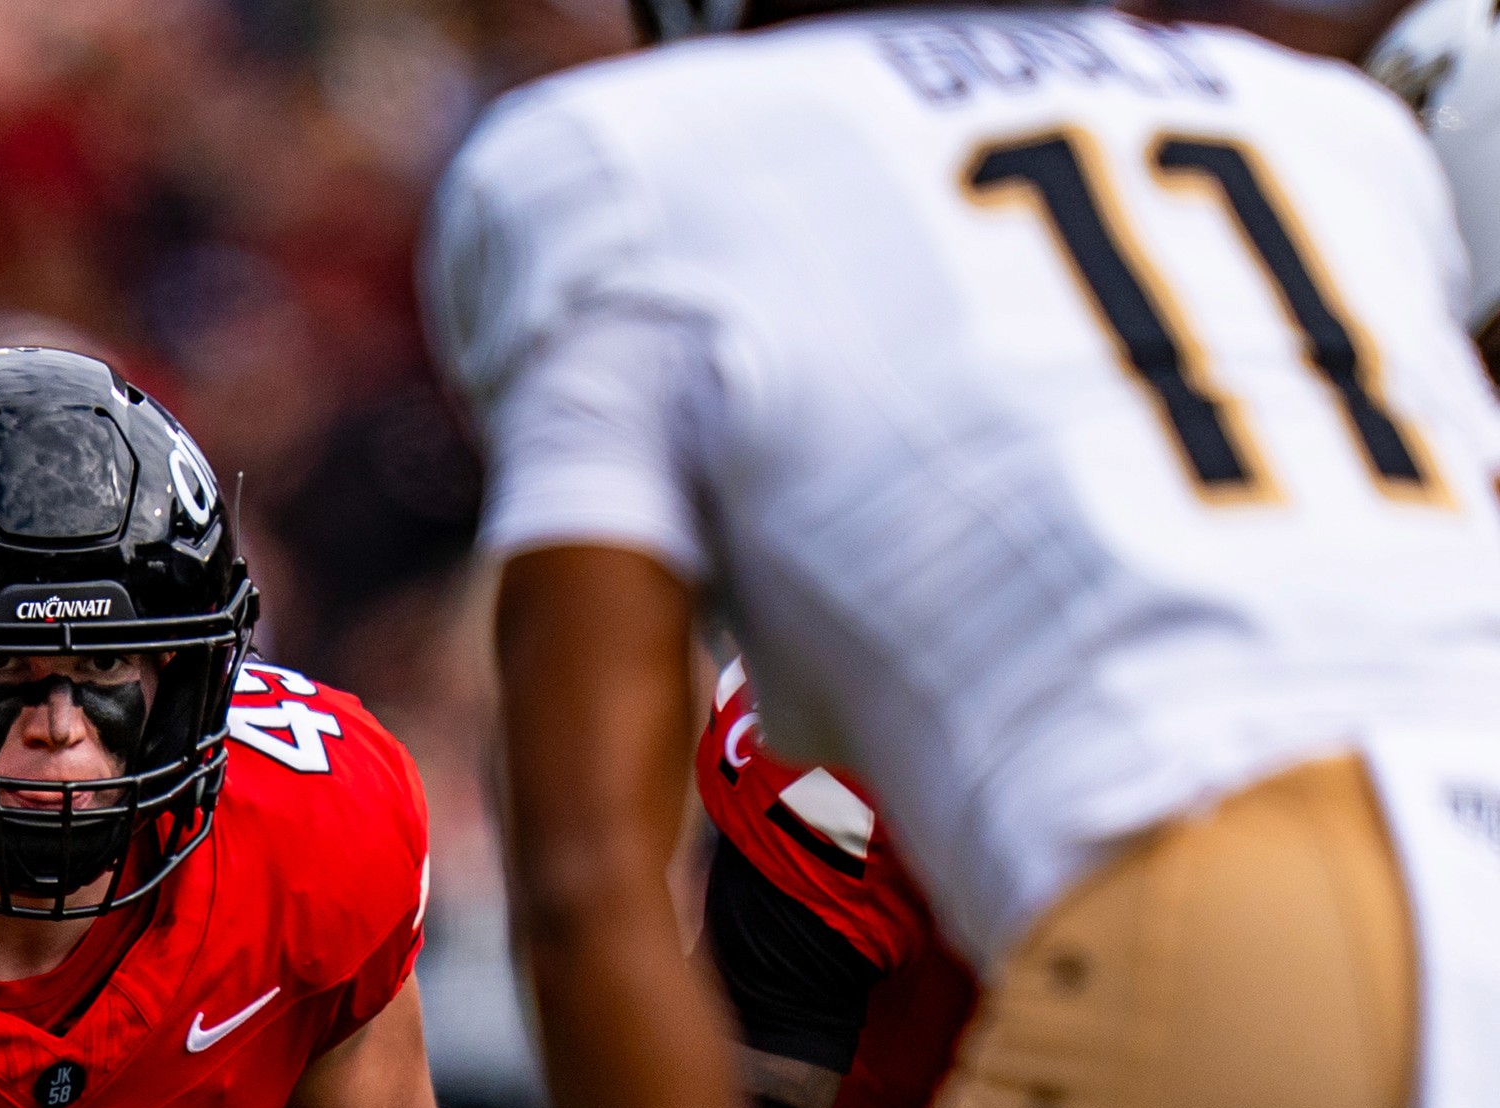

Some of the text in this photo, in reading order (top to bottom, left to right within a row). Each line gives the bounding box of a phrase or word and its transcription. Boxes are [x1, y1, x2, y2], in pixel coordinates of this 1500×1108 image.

[958, 122, 1457, 508] 11
[16, 599, 111, 619] CINCINNATI
[51, 1066, 73, 1085] JK
[47, 1085, 72, 1105] 58
